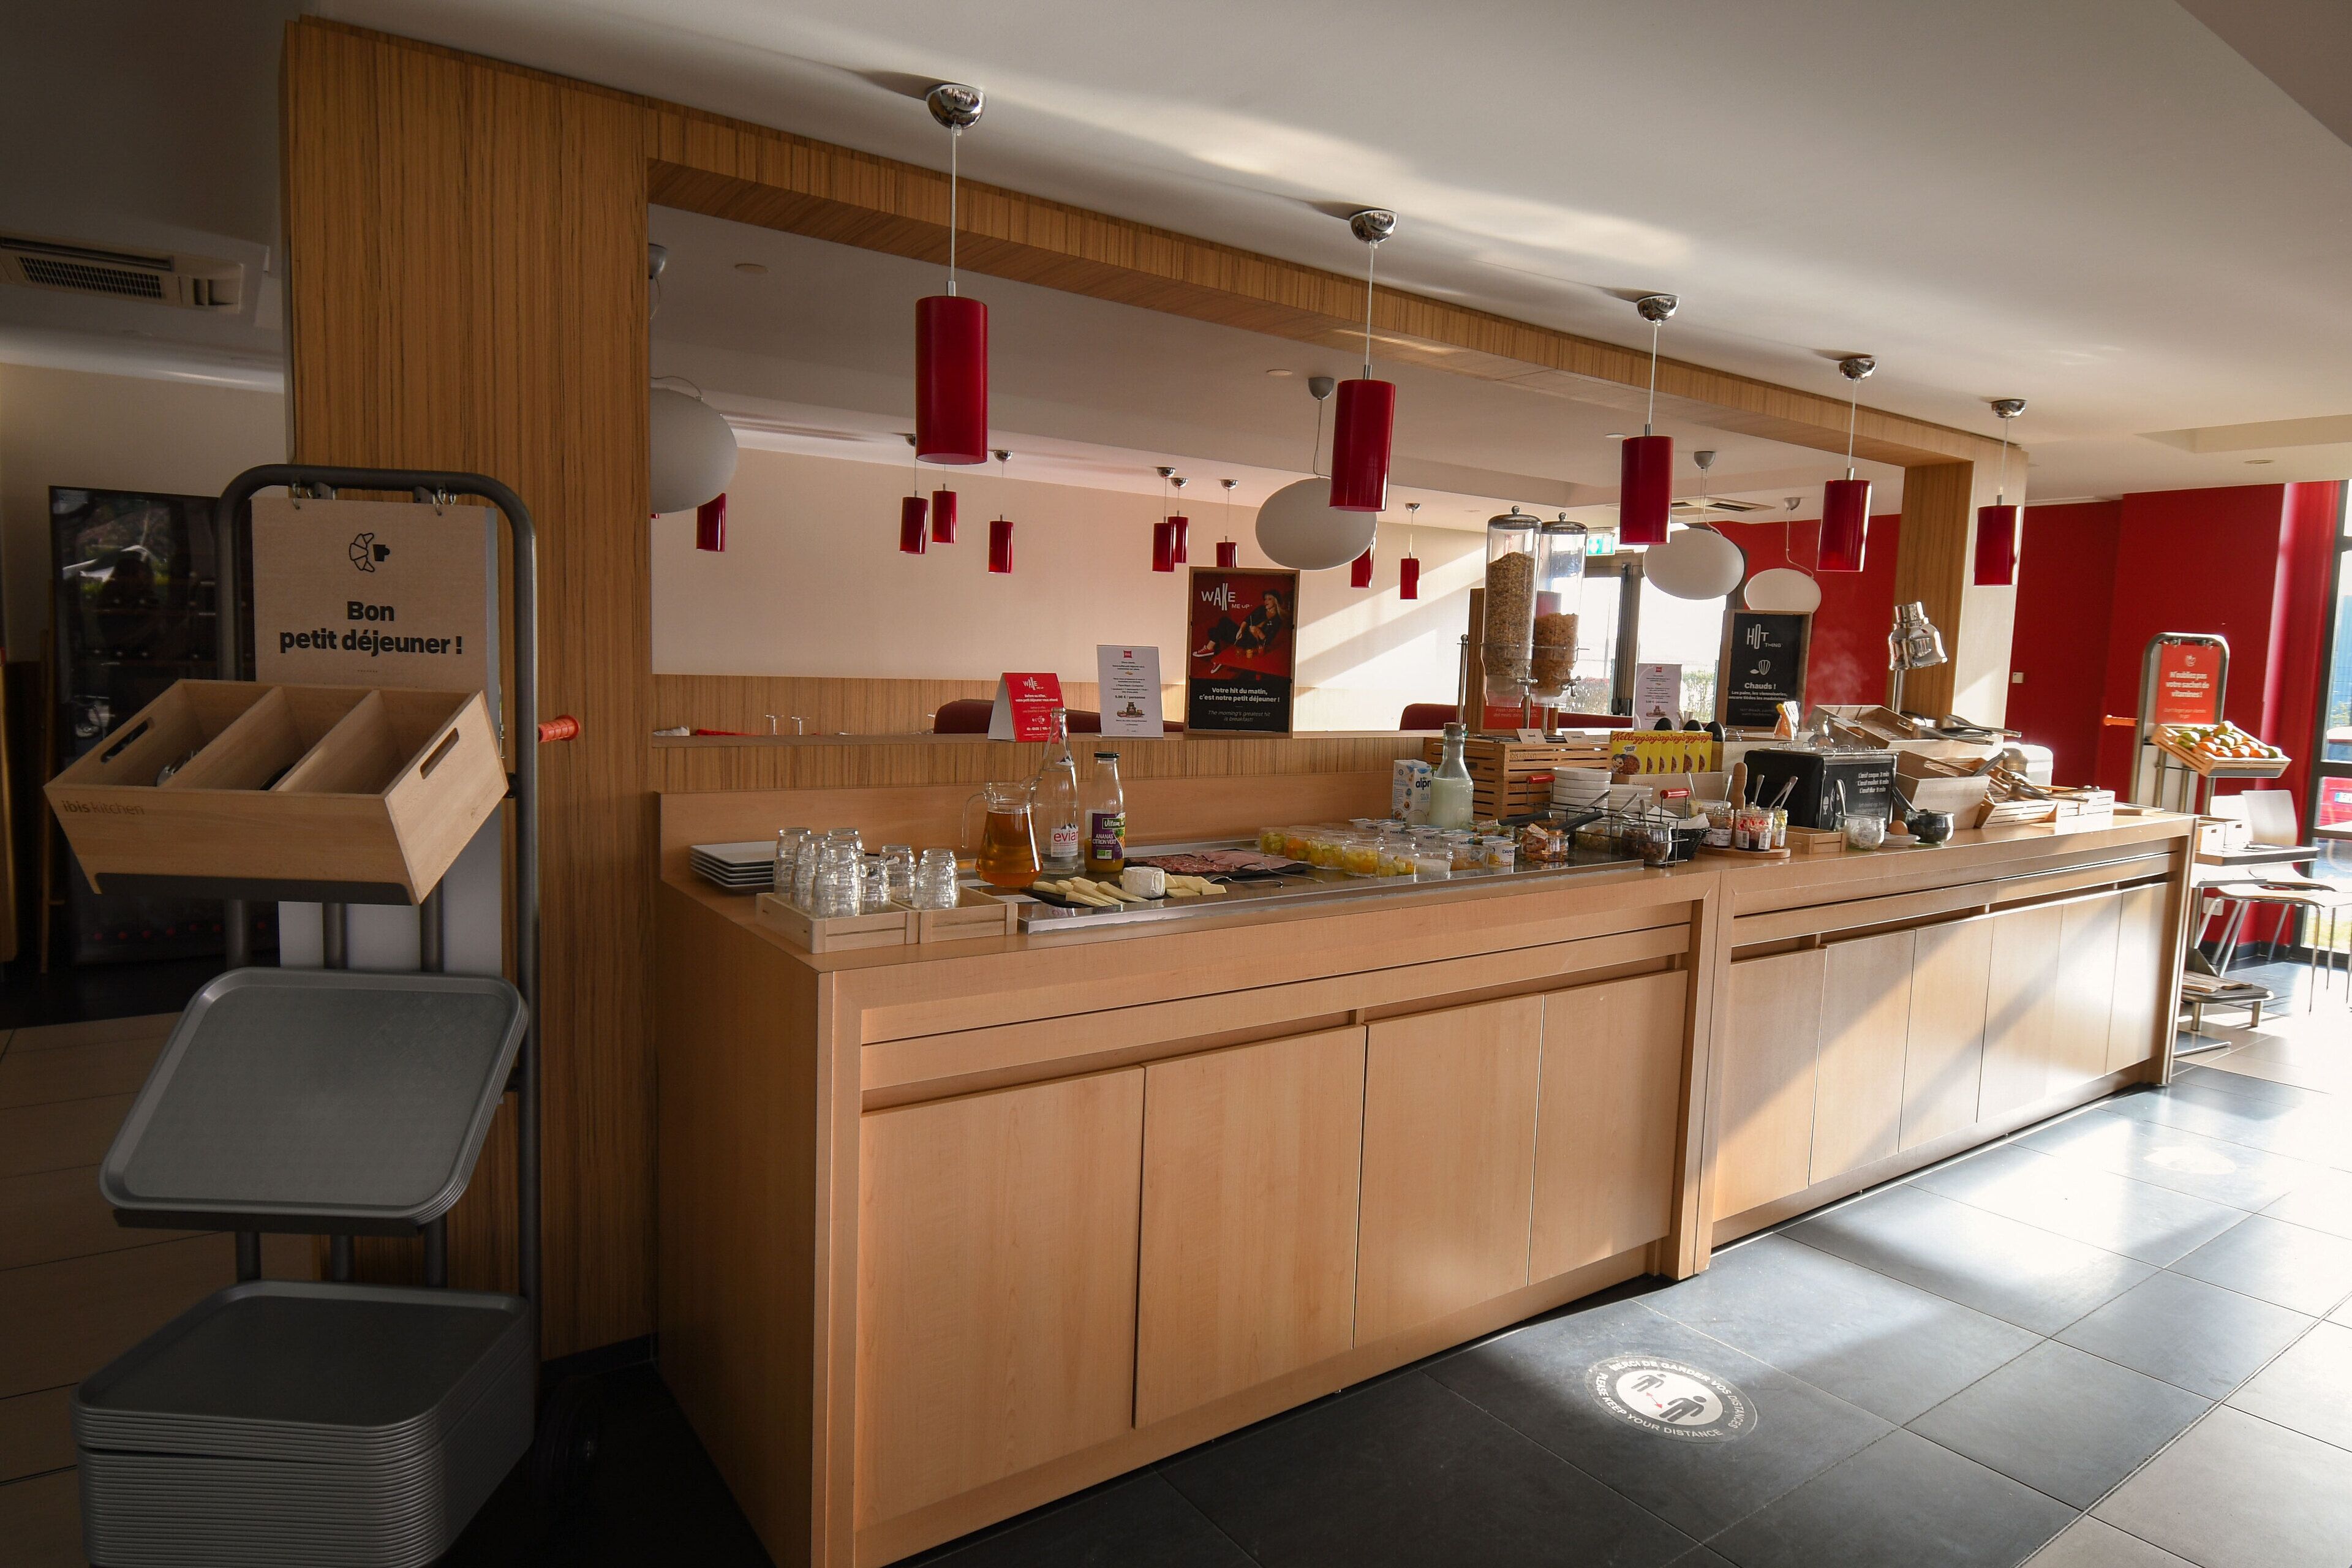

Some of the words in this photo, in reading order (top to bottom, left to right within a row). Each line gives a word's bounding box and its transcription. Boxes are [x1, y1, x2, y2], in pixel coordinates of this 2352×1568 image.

[1201, 582, 1236, 611] WAKE
[347, 600, 395, 621] Bon
[279, 628, 337, 654] petit
[341, 629, 451, 657] déjeuner
[456, 636, 462, 655] !
[1746, 624, 1770, 649] HOT
[1612, 731, 1649, 745] Kellogg's
[1415, 777, 1431, 790] alpr
[61, 801, 90, 813] ibis
[90, 801, 145, 815] kitchen
[1595, 1373, 1609, 1396] PLEASE
[1602, 1396, 1628, 1414] KEEP
[1627, 1413, 1660, 1431] YOUR
[1664, 1427, 1724, 1438] DISTANCE
[1608, 1360, 1640, 1371] MERCI
[1661, 1362, 1711, 1382] GARDER
[1711, 1381, 1732, 1395] VOS
[1727, 1394, 1744, 1430] DISTANCES
